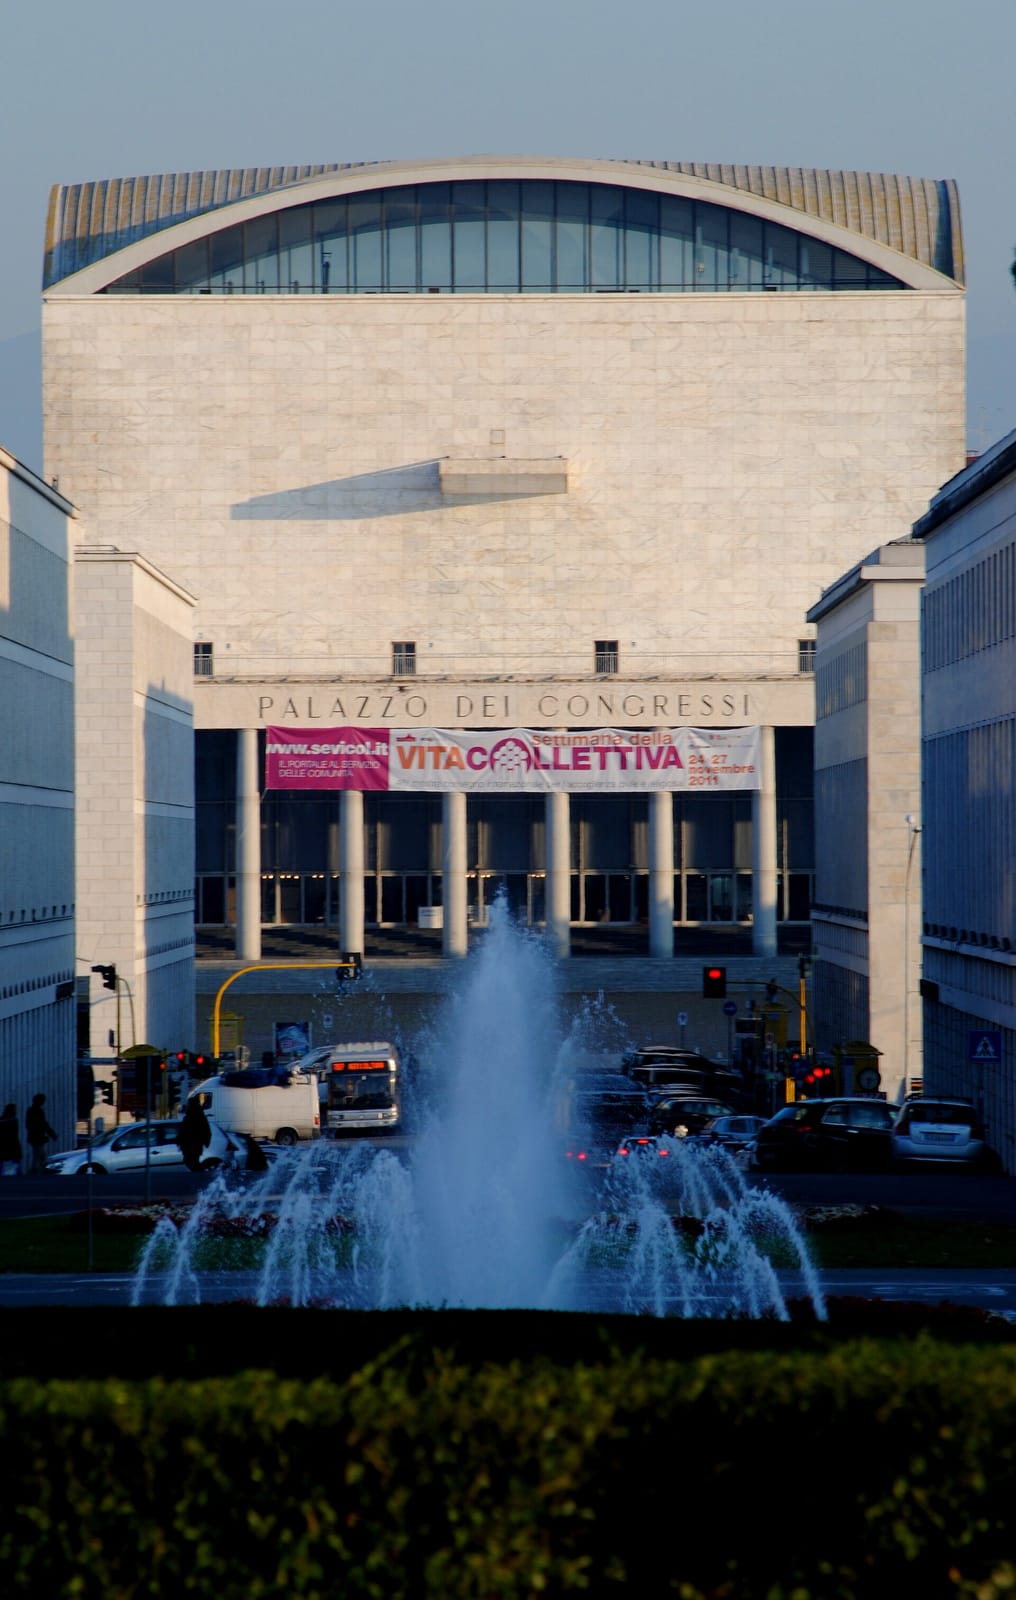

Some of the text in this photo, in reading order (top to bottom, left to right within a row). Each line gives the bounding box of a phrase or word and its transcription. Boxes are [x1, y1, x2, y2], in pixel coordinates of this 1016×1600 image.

[258, 694, 749, 719] PALAZZO DEI CONGRESSI
[628, 733, 673, 746] della
